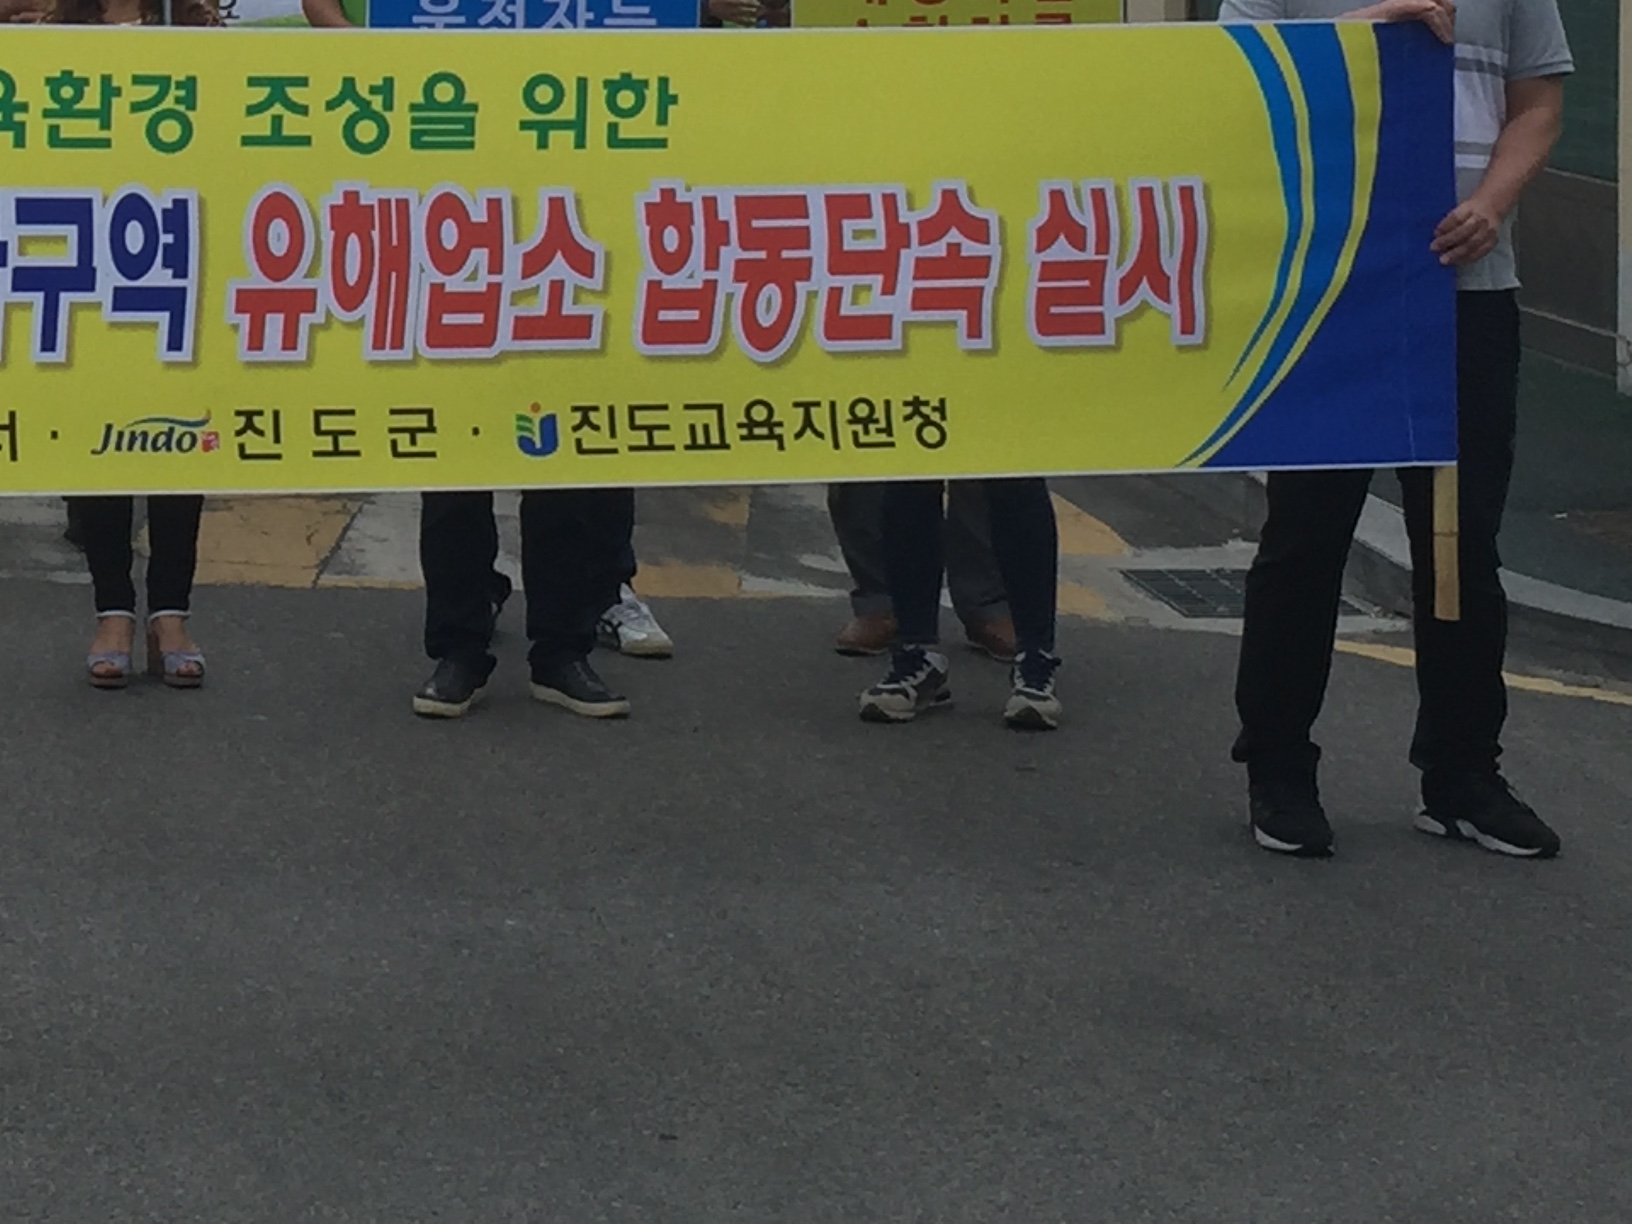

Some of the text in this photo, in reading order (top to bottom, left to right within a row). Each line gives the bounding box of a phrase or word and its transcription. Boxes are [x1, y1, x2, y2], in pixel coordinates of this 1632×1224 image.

[240, 71, 480, 156] 조성을
[518, 71, 679, 152] 위한
[230, 185, 600, 355] 유해업소
[638, 183, 995, 357] 합동단속
[1029, 181, 1201, 343] 실시
[91, 422, 199, 457] Jindo
[233, 406, 439, 461] 진도군
[570, 395, 949, 457] 진도교육지원청
